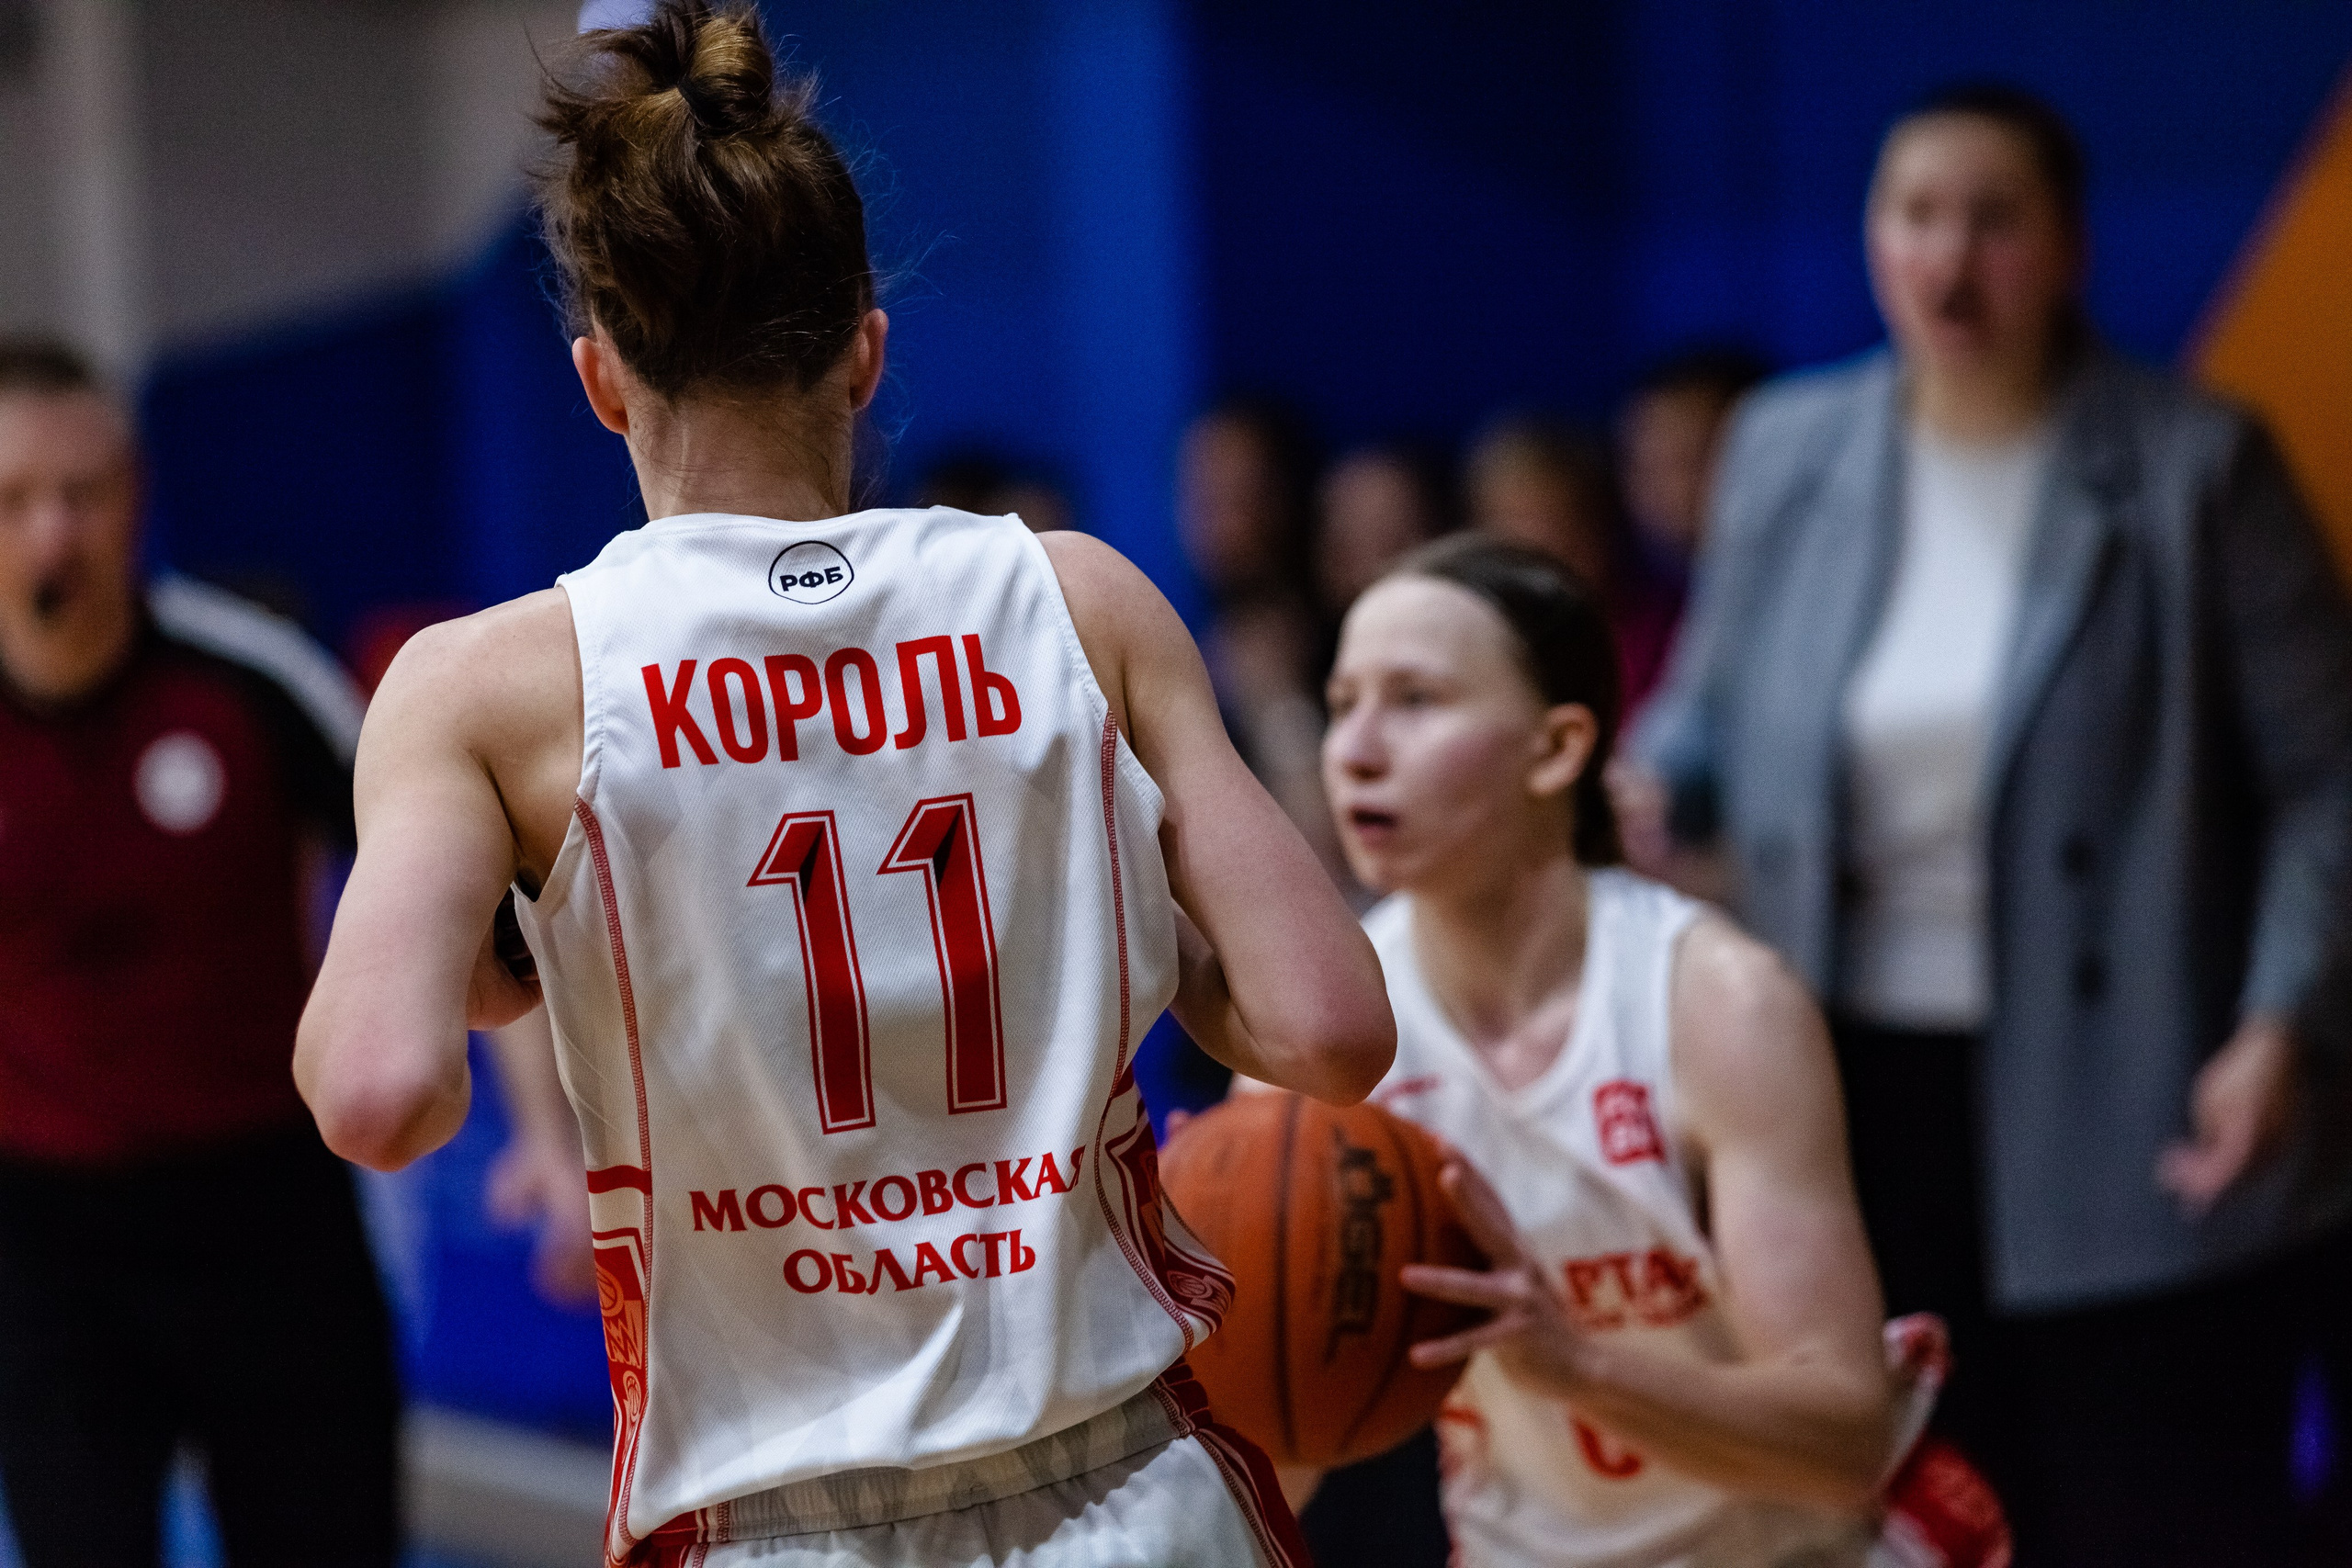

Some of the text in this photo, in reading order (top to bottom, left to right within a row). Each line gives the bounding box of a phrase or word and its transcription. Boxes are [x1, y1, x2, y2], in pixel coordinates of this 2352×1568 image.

[780, 566, 843, 592] РФБ
[640, 633, 1023, 769] КОРОЛЬ
[746, 792, 1008, 1135] 11
[688, 1144, 1086, 1233] МОСКОВСКАЯ
[783, 1228, 1036, 1296] ОБЛАСТЬ
